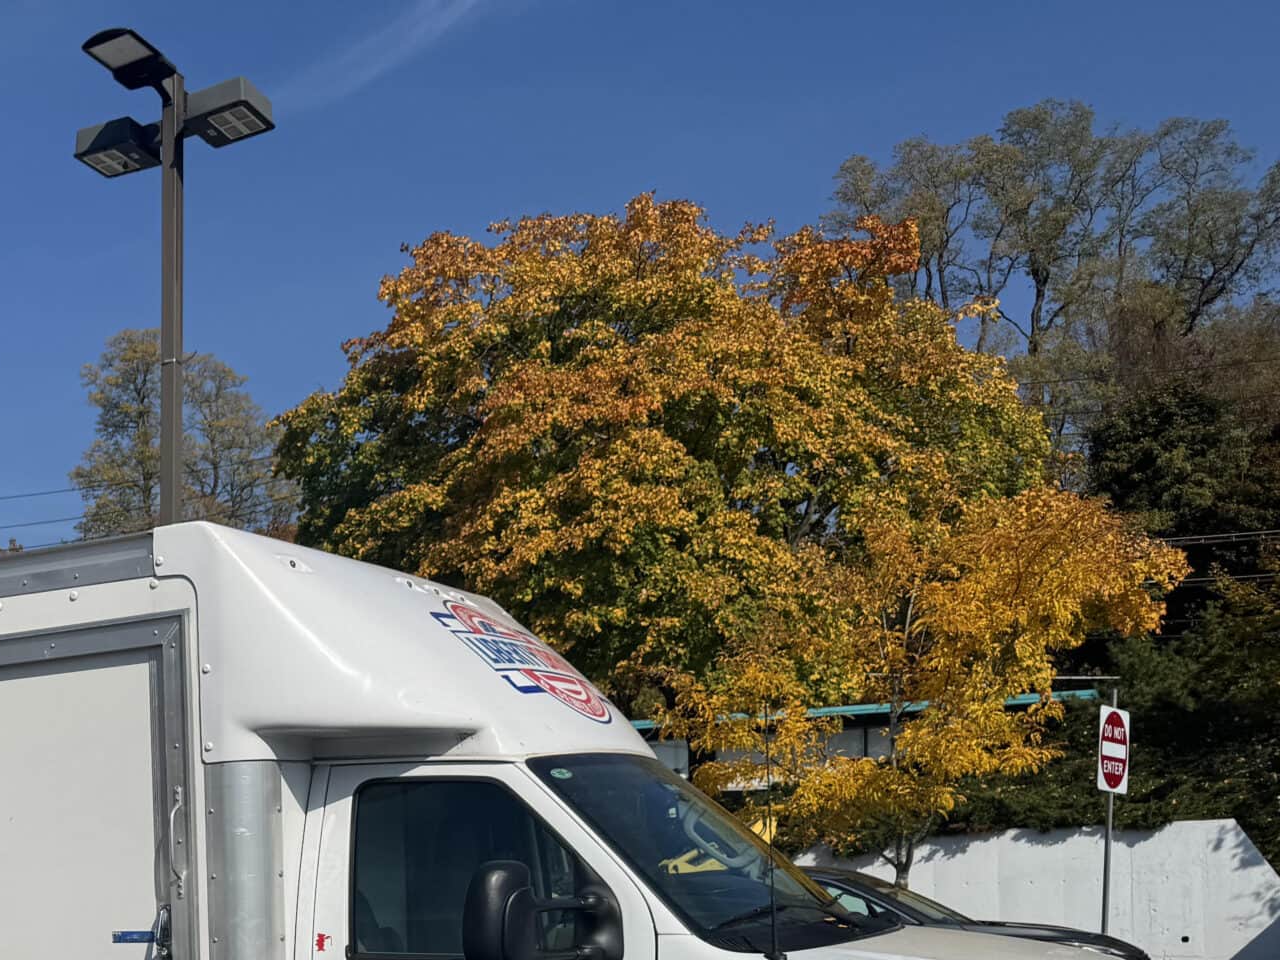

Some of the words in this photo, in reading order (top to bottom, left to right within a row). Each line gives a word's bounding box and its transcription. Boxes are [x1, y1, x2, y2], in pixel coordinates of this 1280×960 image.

[1104, 724, 1112, 737] DO
[1114, 726, 1125, 740] NOT
[1104, 760, 1123, 776] ENTER
